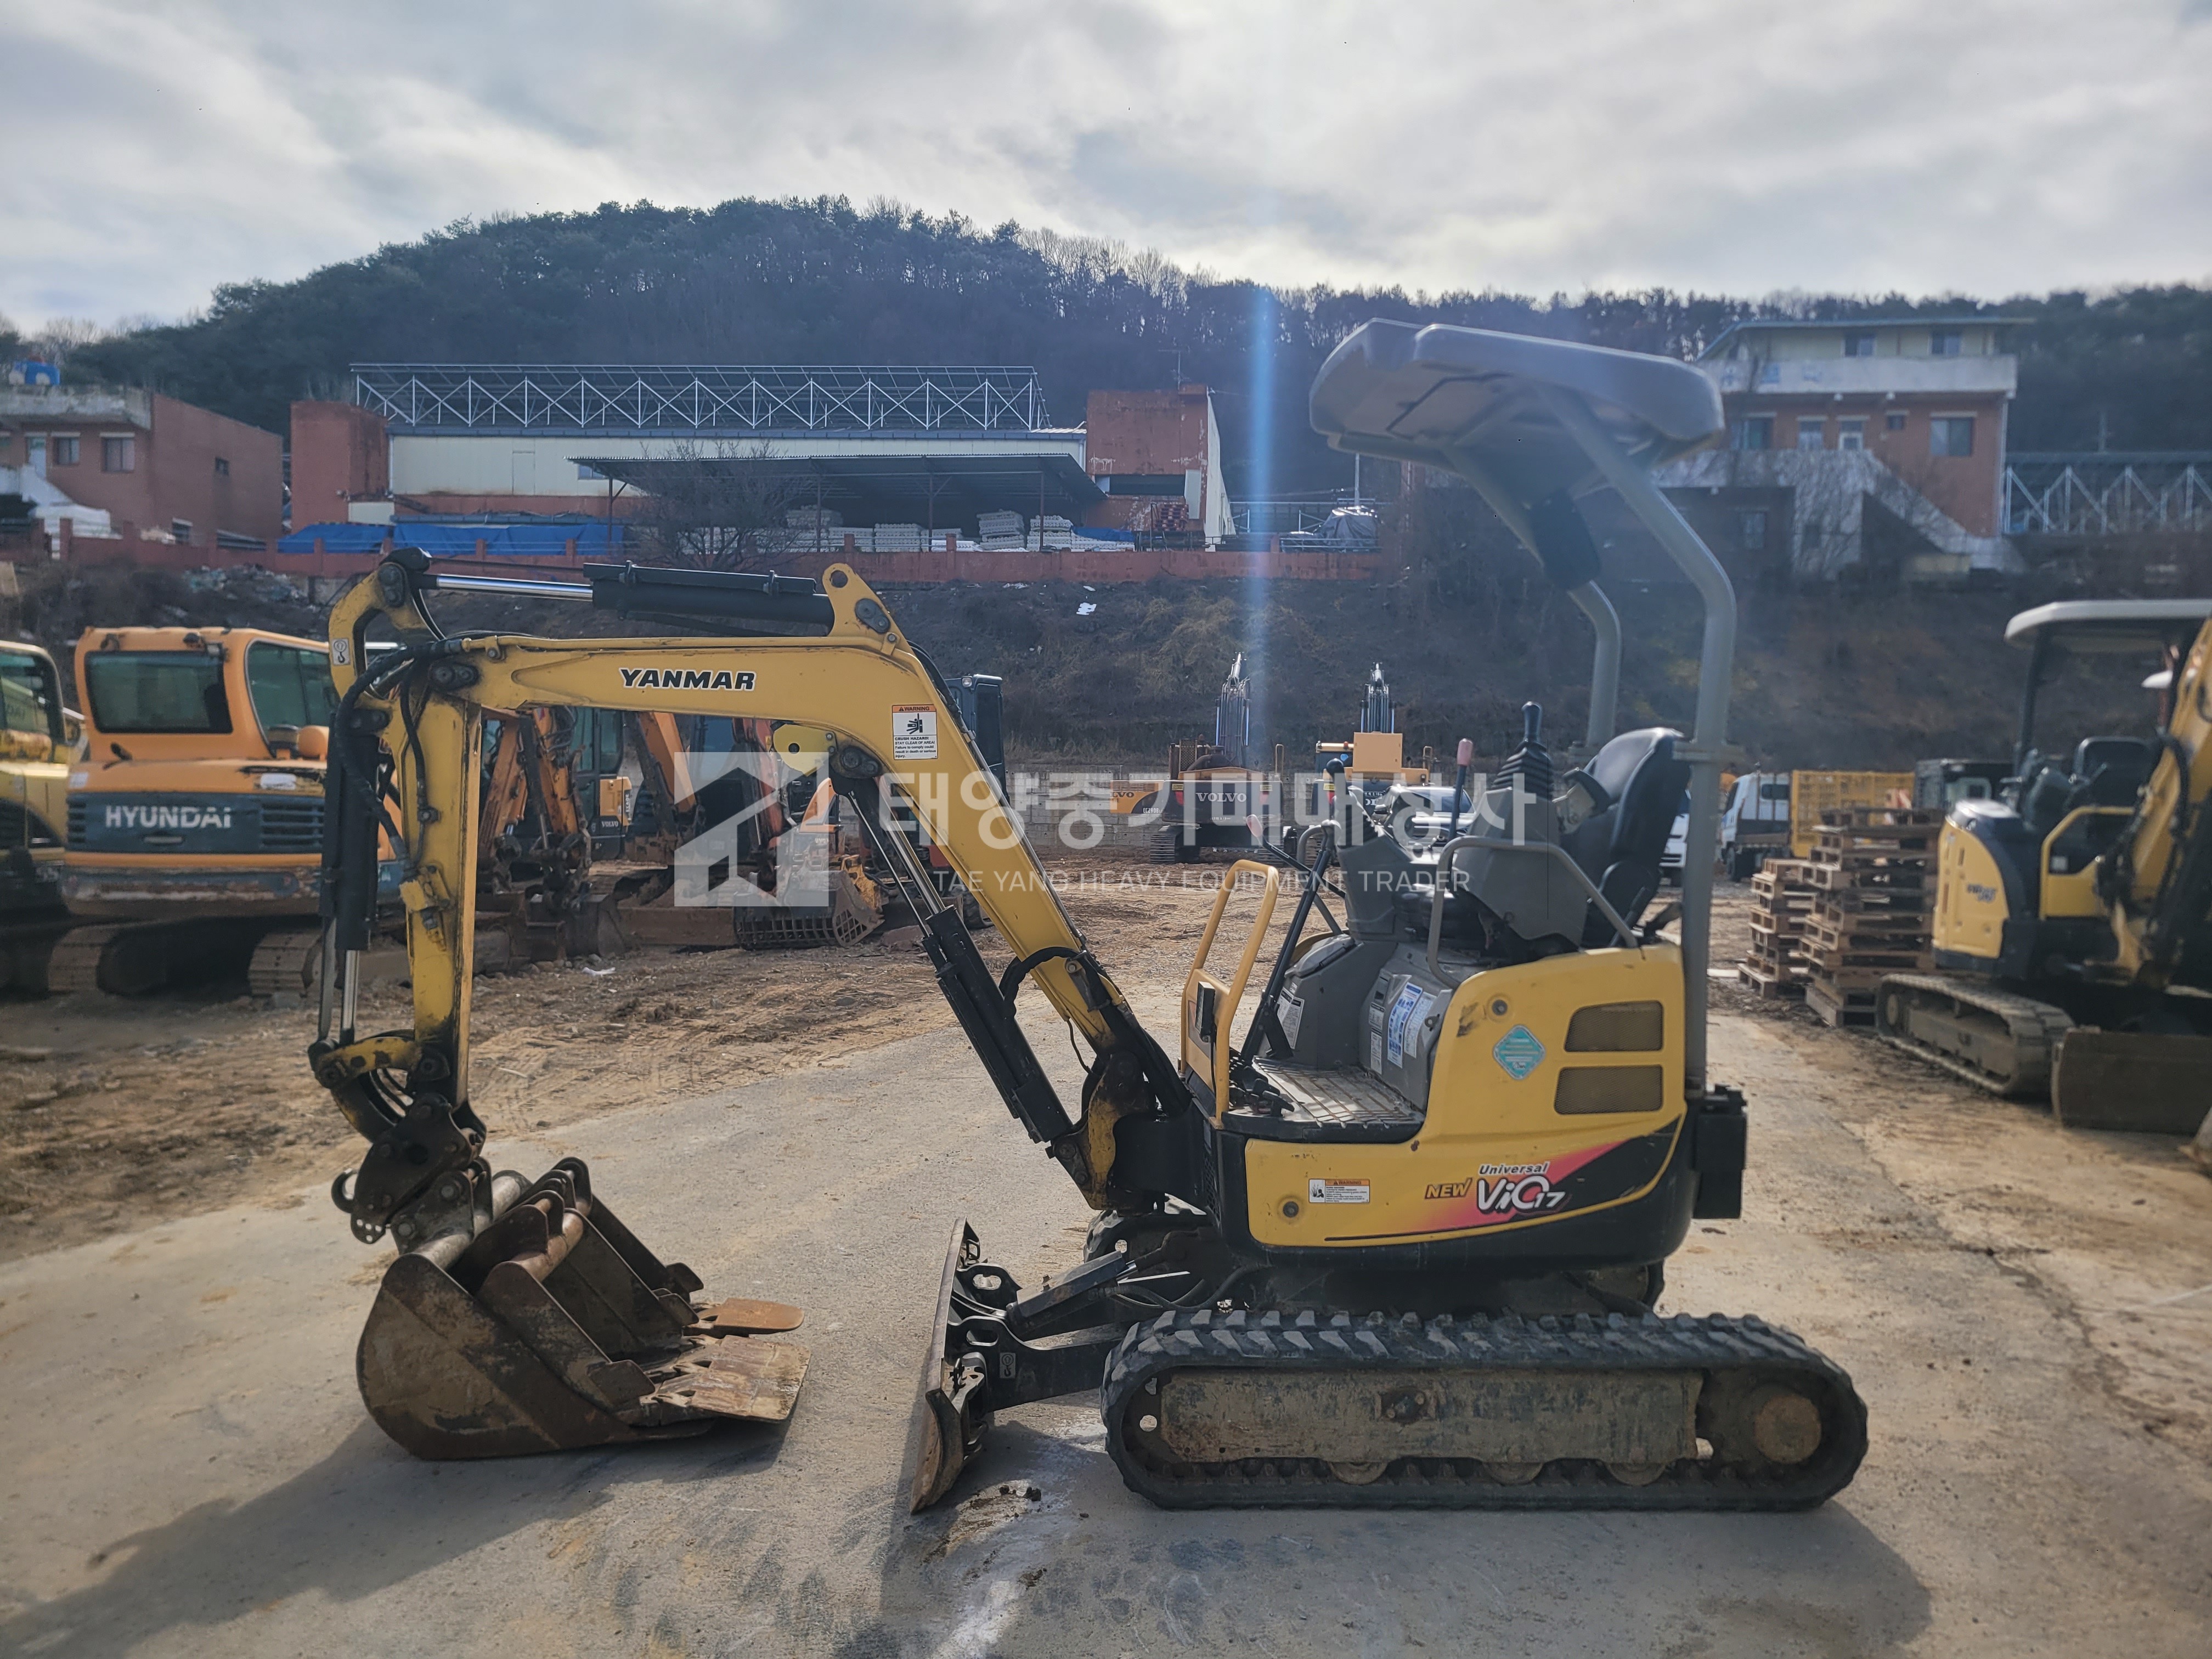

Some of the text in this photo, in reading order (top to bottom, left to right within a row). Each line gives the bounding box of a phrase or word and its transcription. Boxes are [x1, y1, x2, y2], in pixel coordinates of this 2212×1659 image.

[620, 668, 755, 690] YANMAR
[1195, 792, 1247, 803] VOLVO
[105, 805, 232, 828] HYUNDAI
[1480, 1161, 1549, 1175] Universal
[1425, 1177, 1472, 1199] NEW
